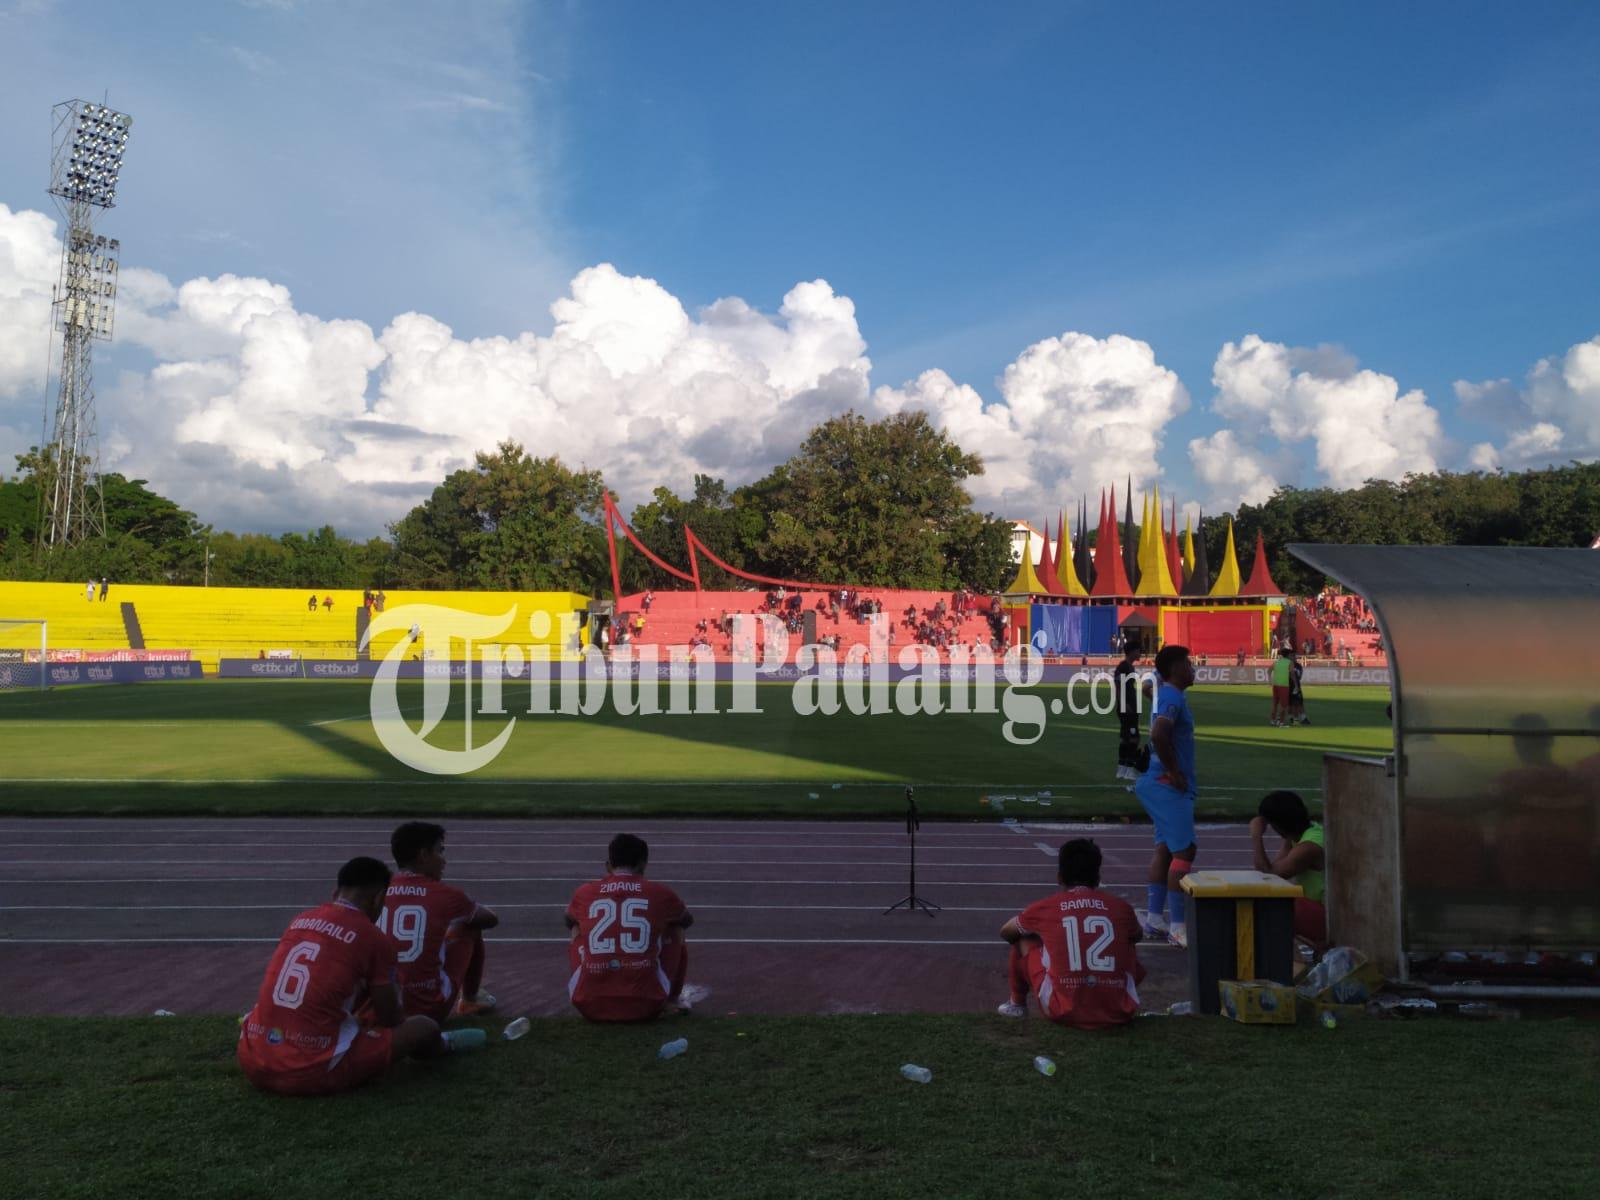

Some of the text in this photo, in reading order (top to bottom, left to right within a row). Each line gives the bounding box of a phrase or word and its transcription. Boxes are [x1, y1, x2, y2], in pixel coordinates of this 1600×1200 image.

[1196, 668, 1230, 682] GUE
[385, 886, 427, 897] DWAN
[600, 881, 642, 893] ZIDANE
[1060, 899, 1109, 911] SAMUEL
[588, 898, 651, 954] 25
[1062, 915, 1115, 971] 12
[272, 941, 321, 1010] 6
